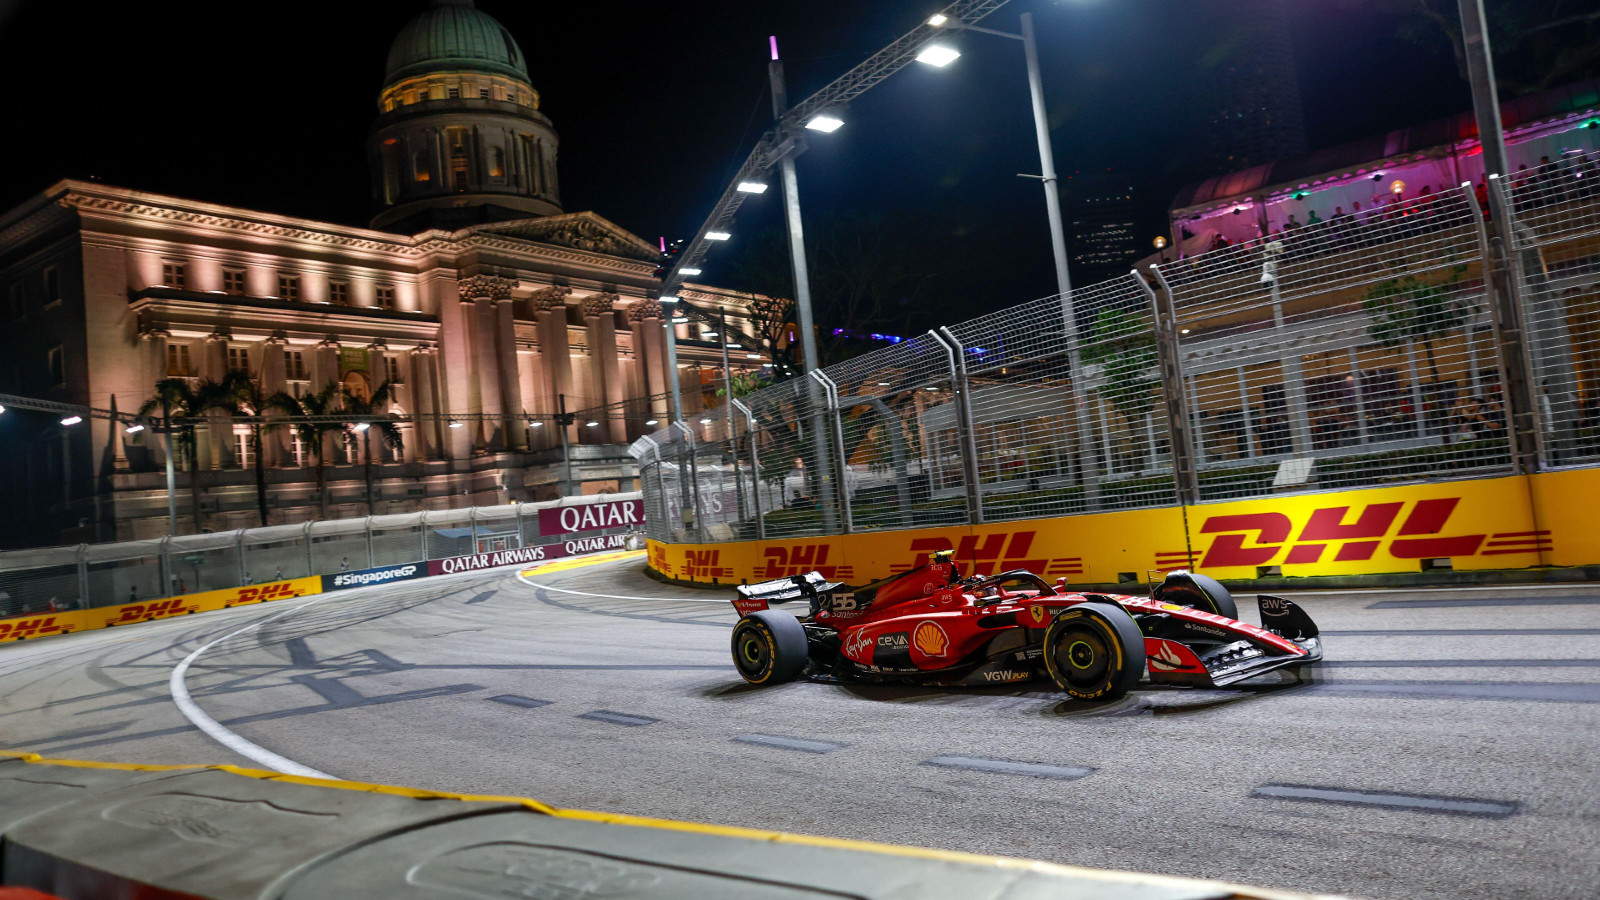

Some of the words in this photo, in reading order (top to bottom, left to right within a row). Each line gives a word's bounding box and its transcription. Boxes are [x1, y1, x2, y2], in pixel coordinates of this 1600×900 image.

[560, 502, 638, 532] QATAR
[1200, 498, 1486, 568] DHL
[565, 537, 606, 555] QATAR
[910, 531, 1048, 577] DHL
[442, 553, 489, 574] QATAR
[492, 546, 545, 567] AIRWAYS
[685, 549, 724, 577] DHL
[764, 544, 837, 578] DHL
[334, 565, 416, 586] #SingaporeGP
[237, 583, 295, 603] DHL
[832, 592, 857, 611] 55
[1262, 599, 1288, 609] aws
[119, 599, 188, 623] DHL
[0, 617, 61, 640] DHL
[1192, 623, 1227, 637] Santander
[984, 670, 1012, 681] VGW
